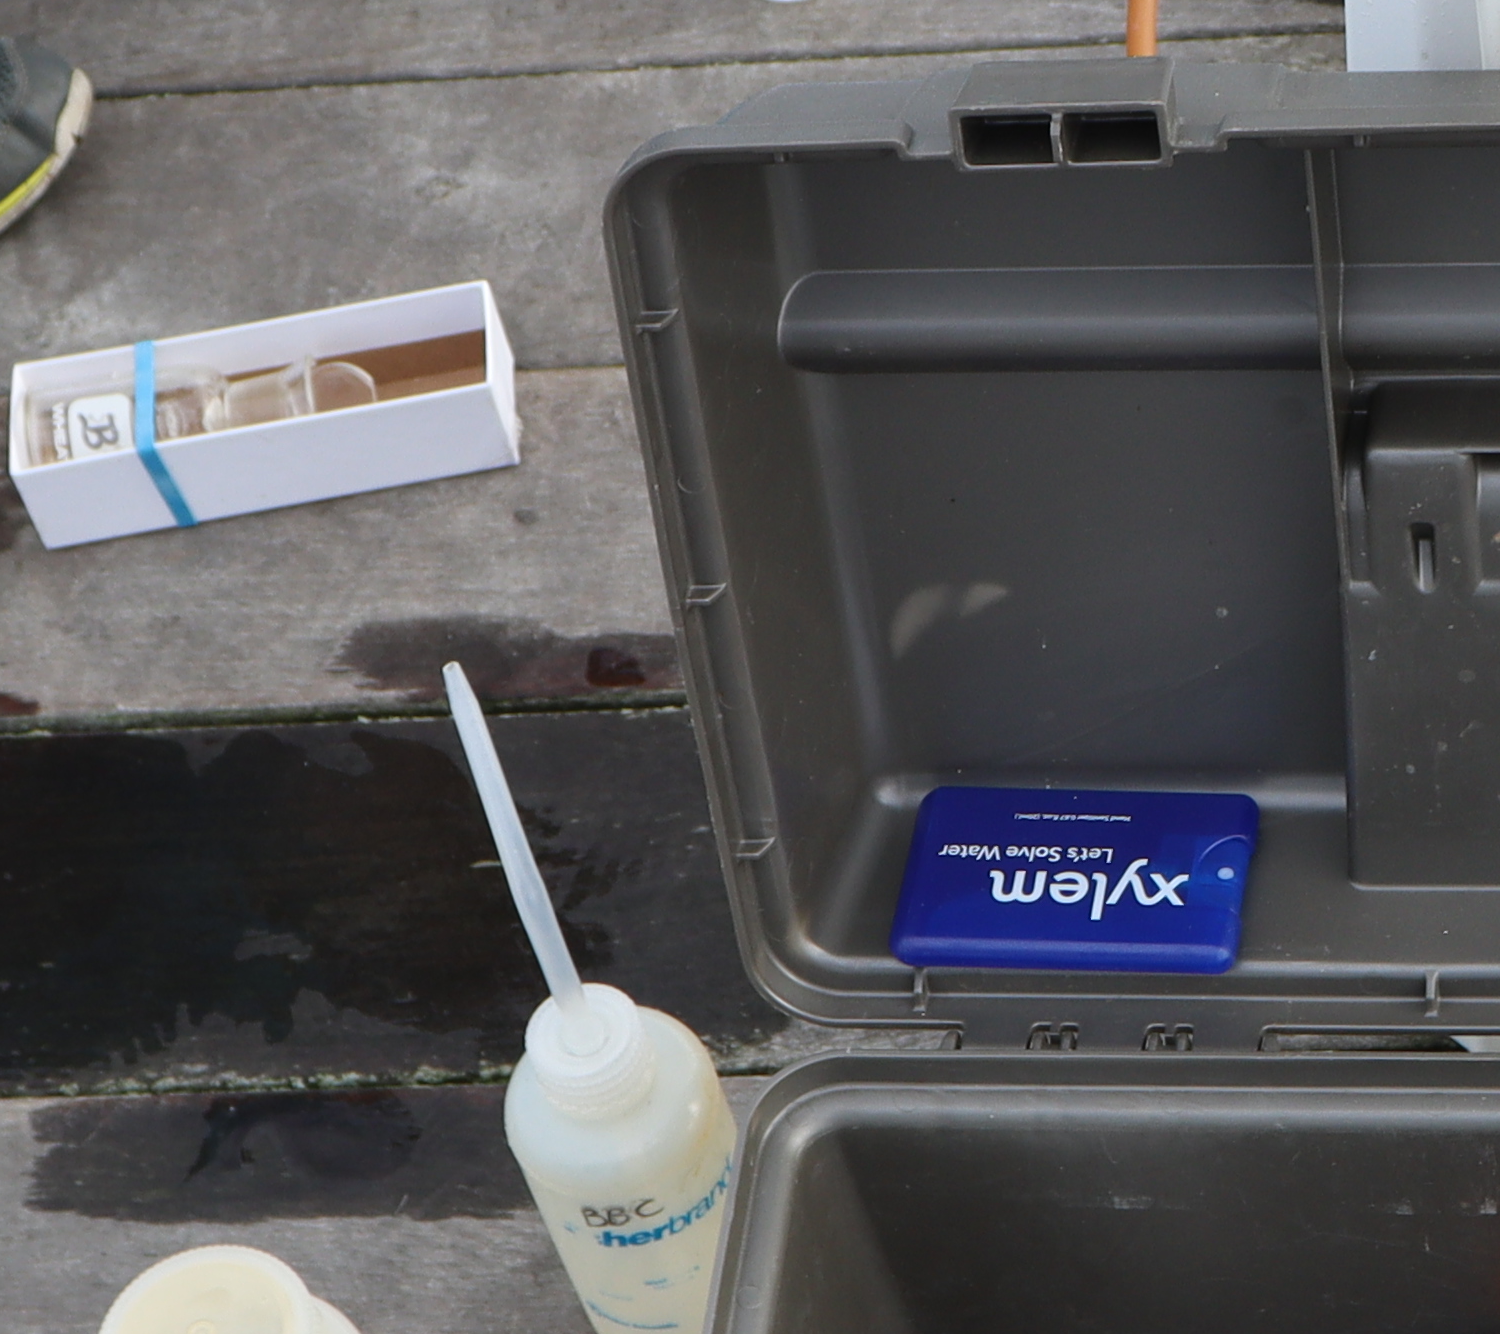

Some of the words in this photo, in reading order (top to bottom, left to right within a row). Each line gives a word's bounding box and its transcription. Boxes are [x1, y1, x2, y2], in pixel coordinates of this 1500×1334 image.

[938, 842, 1001, 861] Water
[1005, 844, 1062, 863] Solve
[1066, 845, 1114, 865] Let's
[989, 858, 1190, 921] xylem
[581, 1198, 665, 1228] BBC
